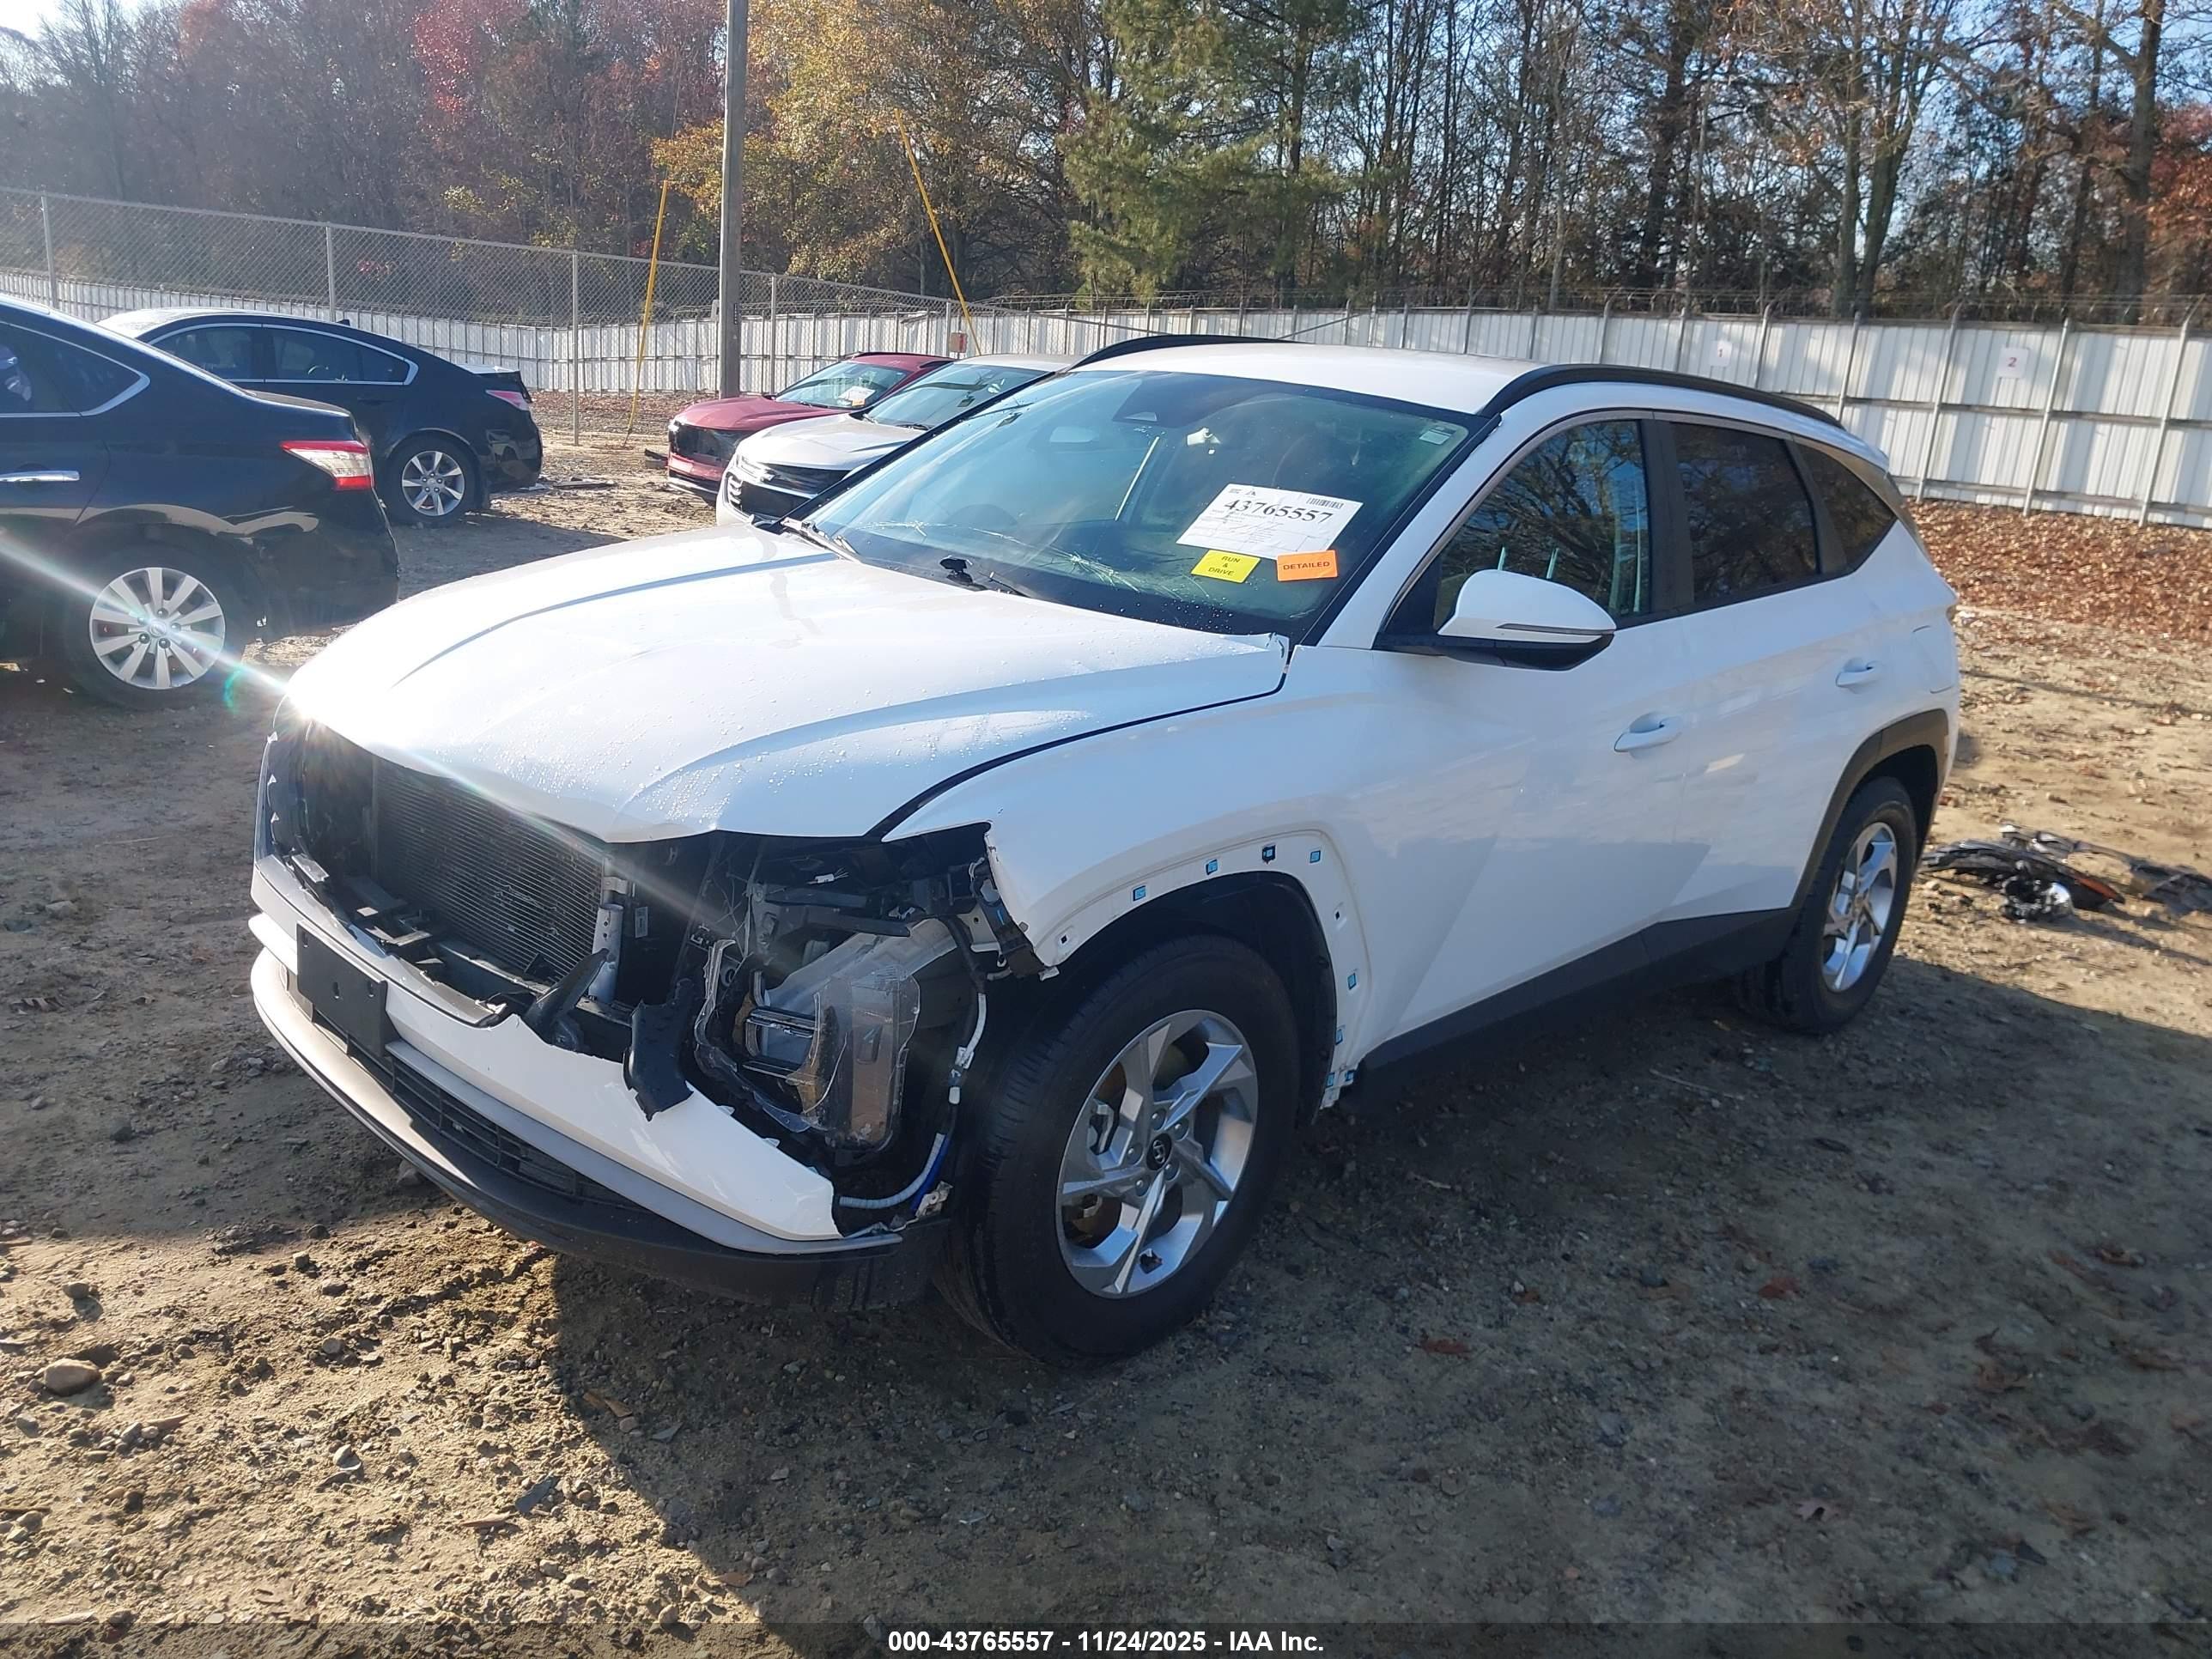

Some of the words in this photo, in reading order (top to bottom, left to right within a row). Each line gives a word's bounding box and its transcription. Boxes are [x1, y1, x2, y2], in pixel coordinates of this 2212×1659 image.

[2008, 356, 2017, 368] 2
[1224, 499, 1334, 523] 43765557
[1283, 561, 1330, 570] DETAILED
[1208, 567, 1235, 576] DRIVE
